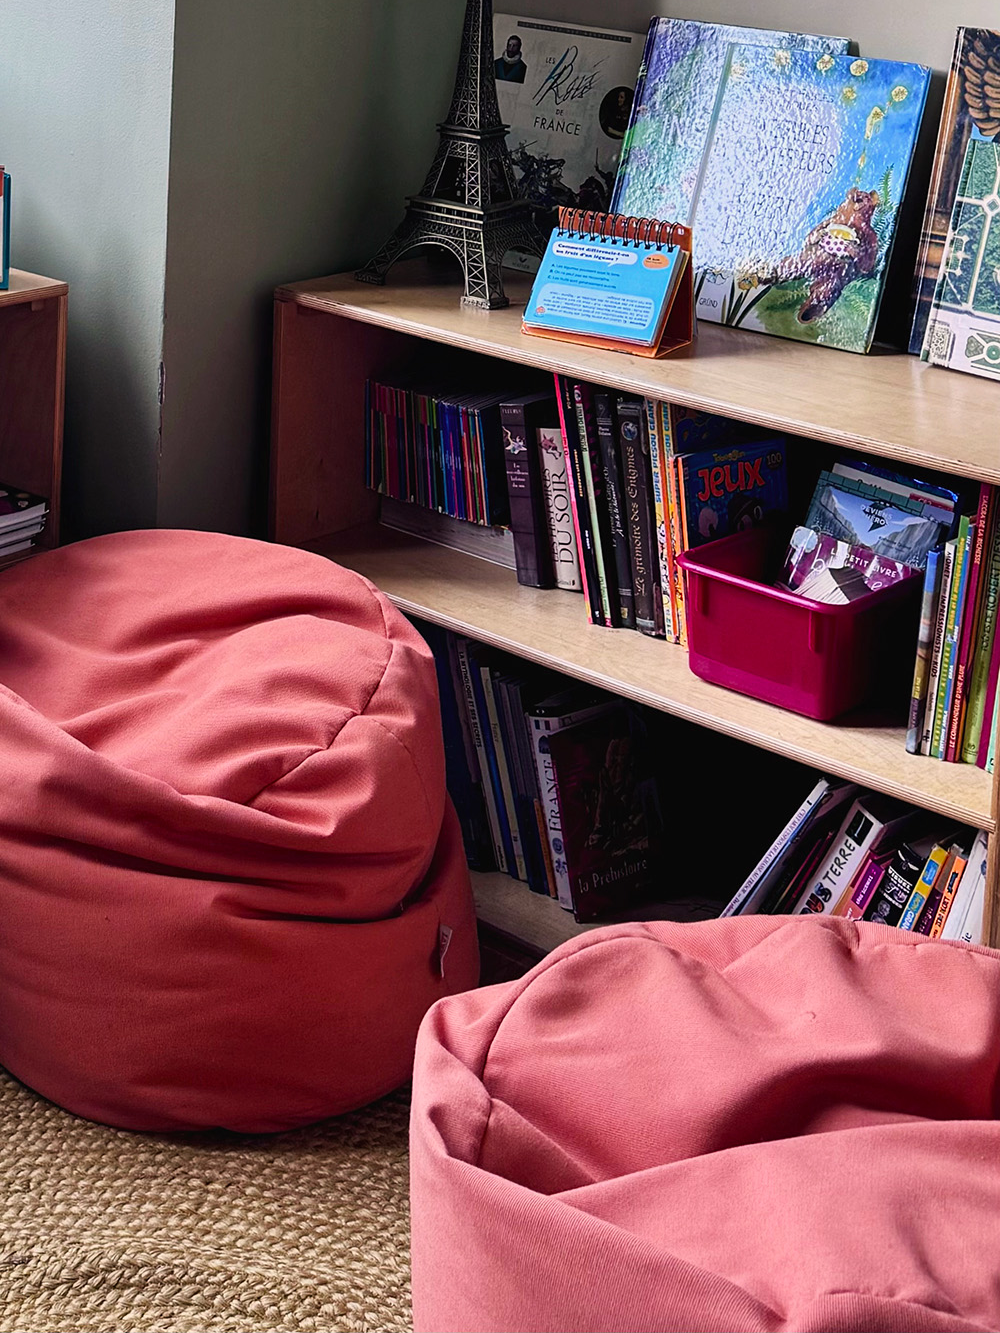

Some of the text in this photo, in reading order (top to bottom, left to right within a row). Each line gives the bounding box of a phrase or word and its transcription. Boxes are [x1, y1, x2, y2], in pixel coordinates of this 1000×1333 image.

[545, 57, 556, 65] LES
[533, 116, 582, 136] FRANCE
[649, 432, 658, 468] PICSOU
[651, 471, 661, 503] SUPER
[541, 467, 556, 538] HISTOIRES
[549, 468, 575, 565] DU SOIR
[628, 502, 640, 521] des
[976, 528, 985, 536] LA
[978, 519, 986, 527] DE
[630, 524, 645, 573] grimoire
[972, 536, 983, 564] RICHESSE
[632, 576, 646, 596] Le
[984, 563, 1000, 612] ROBERT
[932, 594, 947, 653] IMPRESSIONISTS
[930, 659, 939, 678] KIDS
[957, 664, 965, 680] PLUIE
[954, 680, 963, 699] D'UNE
[949, 700, 960, 740] COMMANDEUR
[543, 759, 561, 832] FRANCE
[823, 841, 855, 886] TERRE
